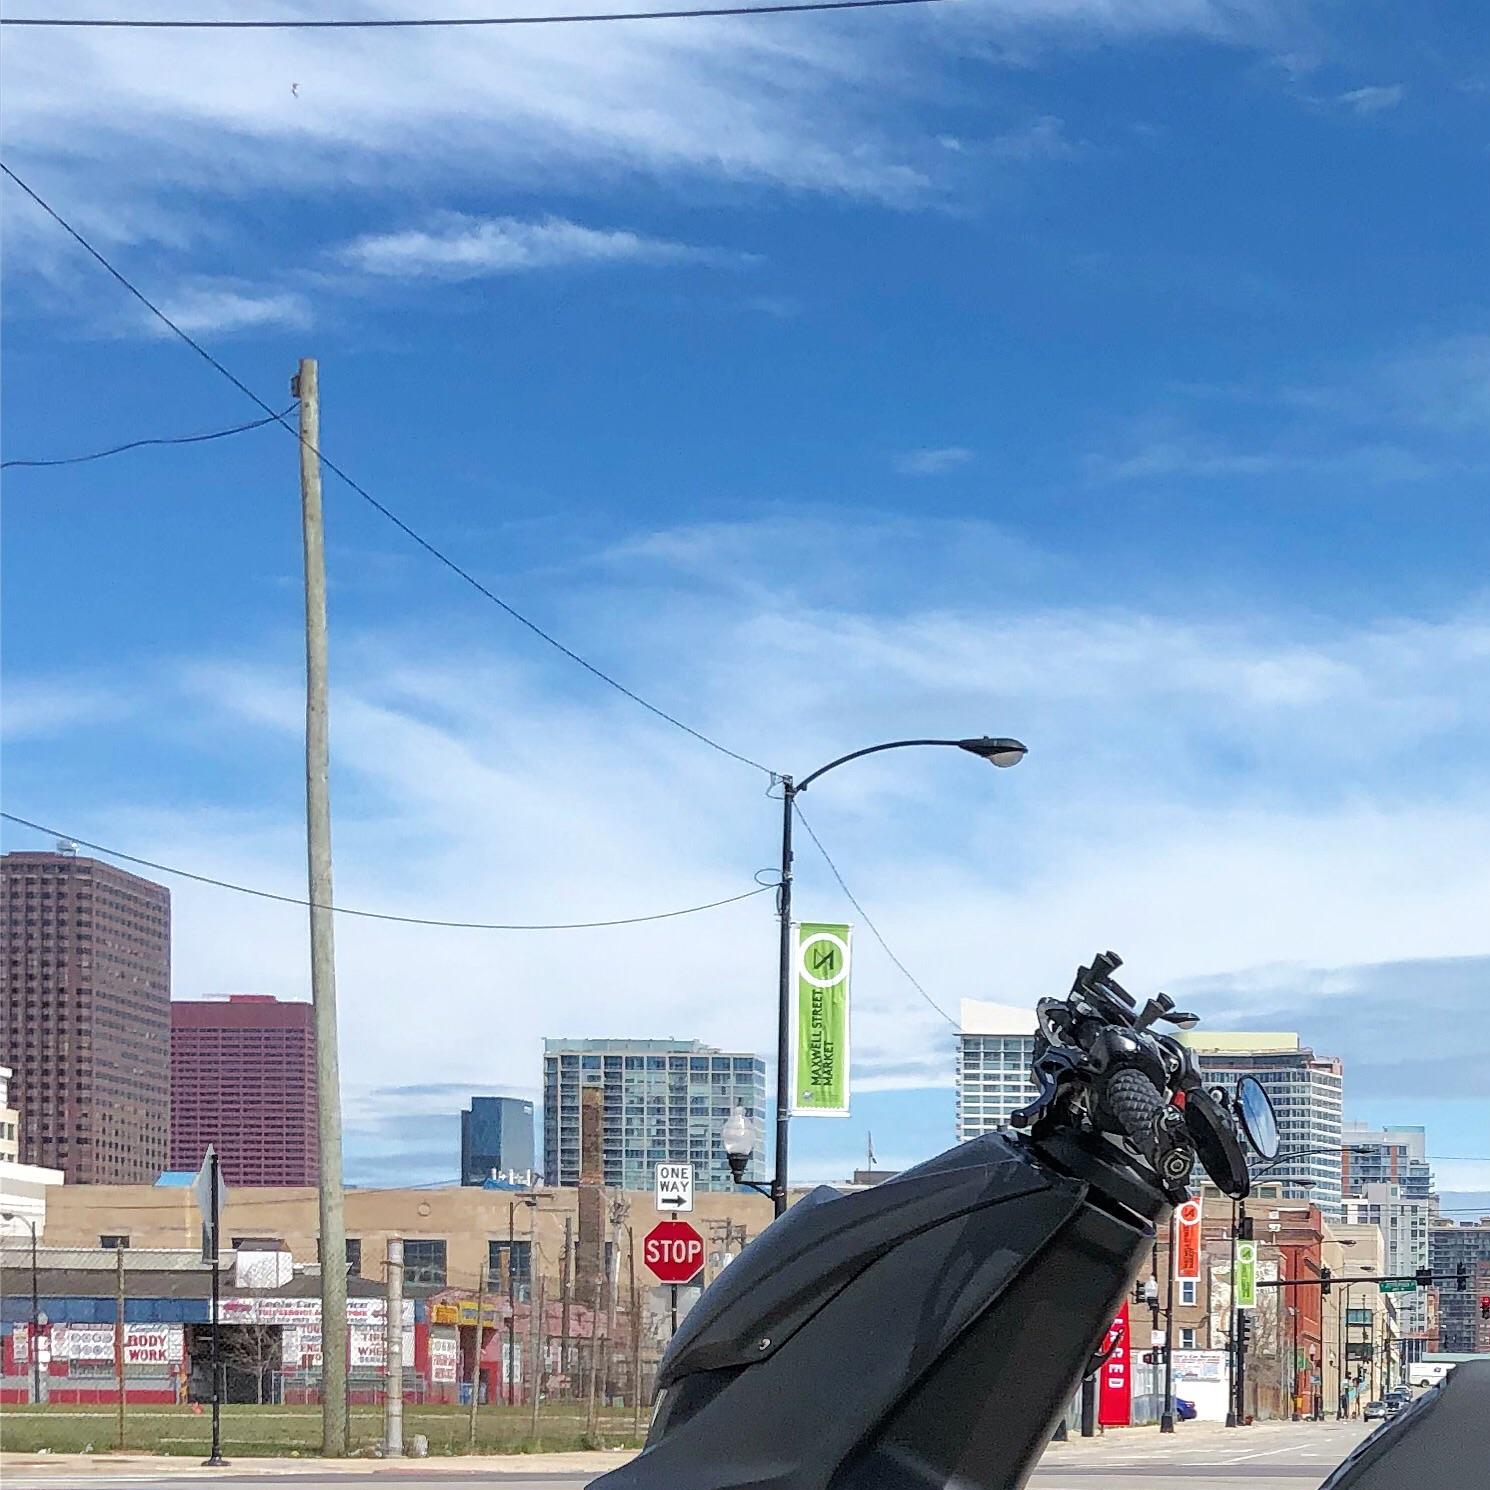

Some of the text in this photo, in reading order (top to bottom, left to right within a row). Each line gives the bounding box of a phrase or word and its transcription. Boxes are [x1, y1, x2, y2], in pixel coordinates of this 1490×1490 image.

[811, 989, 824, 1086] MAXWELL STREET
[823, 1041, 835, 1086] MARKET
[660, 1167, 689, 1180] ONE
[660, 1181, 689, 1193] WAY
[646, 1239, 702, 1263] STOP
[128, 1335, 166, 1347] BODY
[129, 1349, 168, 1362] WORK
